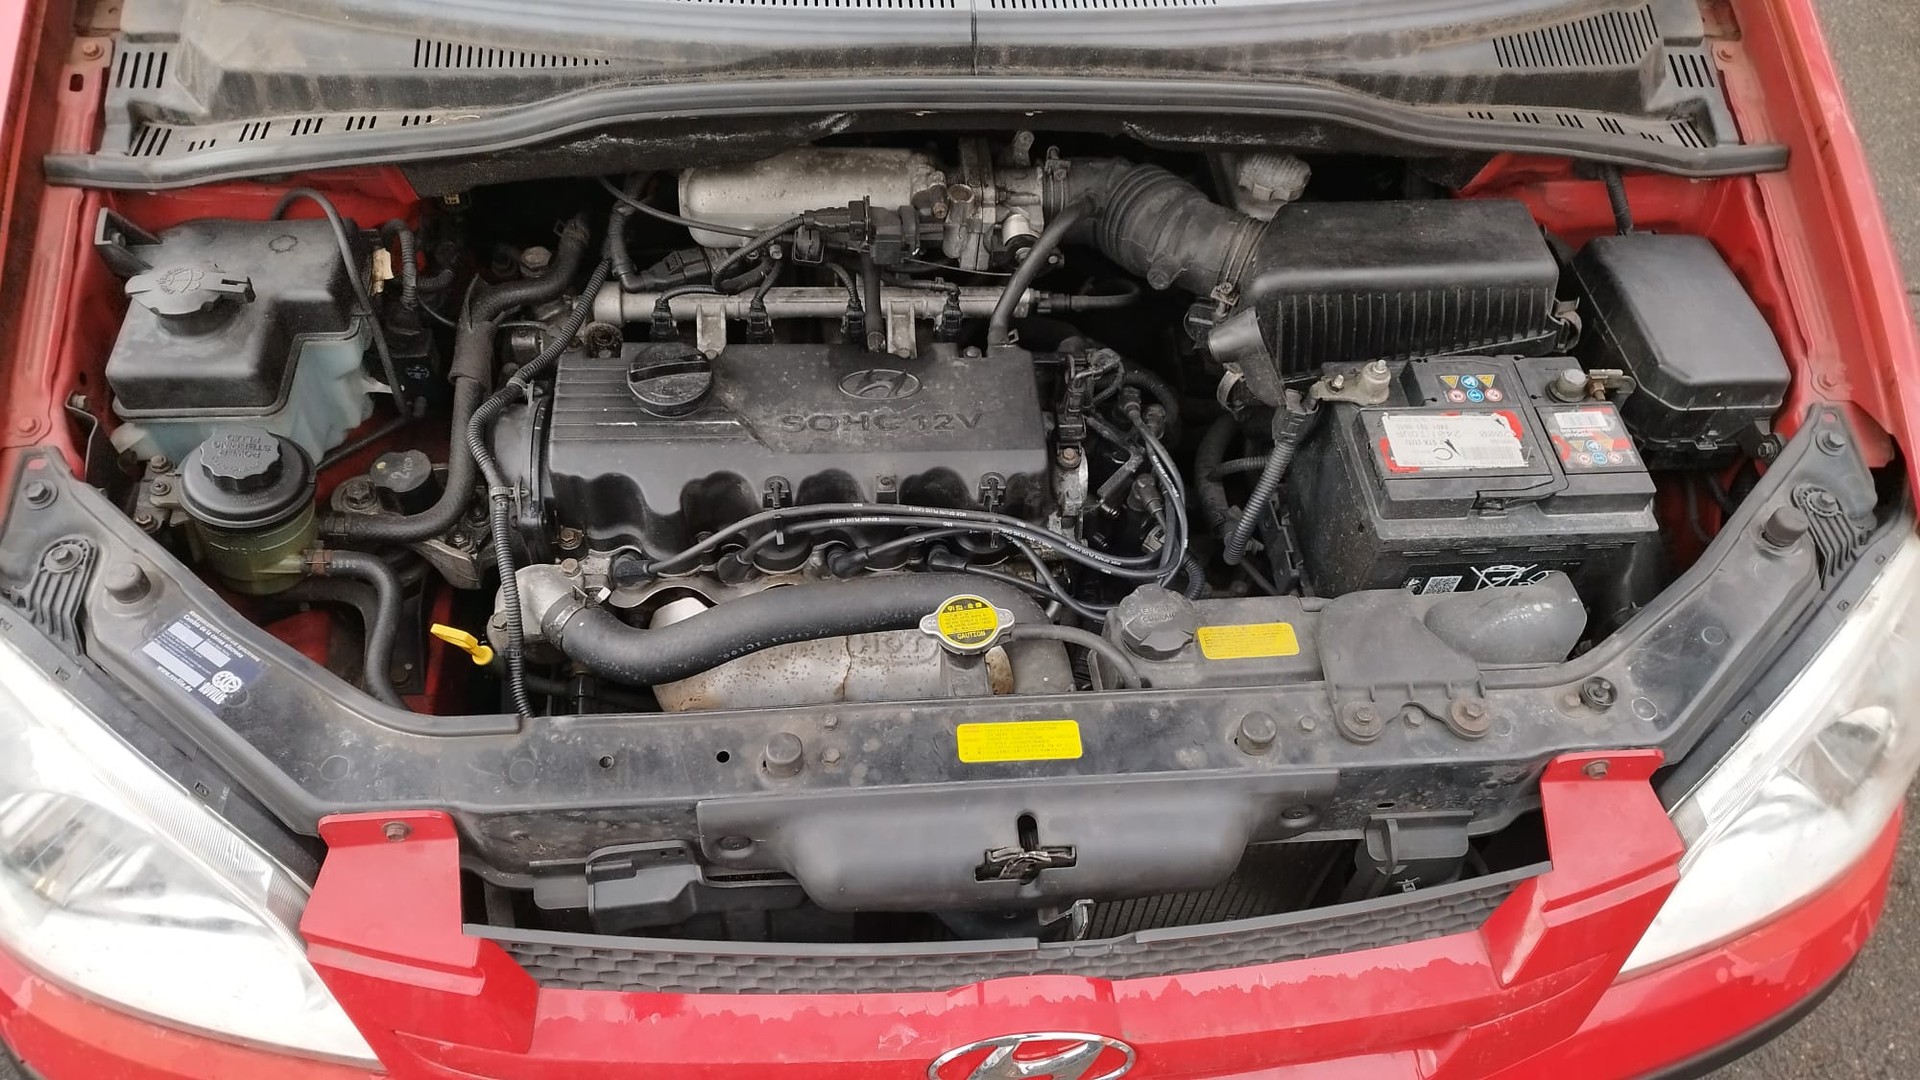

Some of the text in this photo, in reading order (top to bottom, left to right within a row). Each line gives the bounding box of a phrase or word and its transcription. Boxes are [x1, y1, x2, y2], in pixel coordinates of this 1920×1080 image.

[780, 412, 984, 432] SOHC 12V
[956, 630, 987, 640] CAUTION
